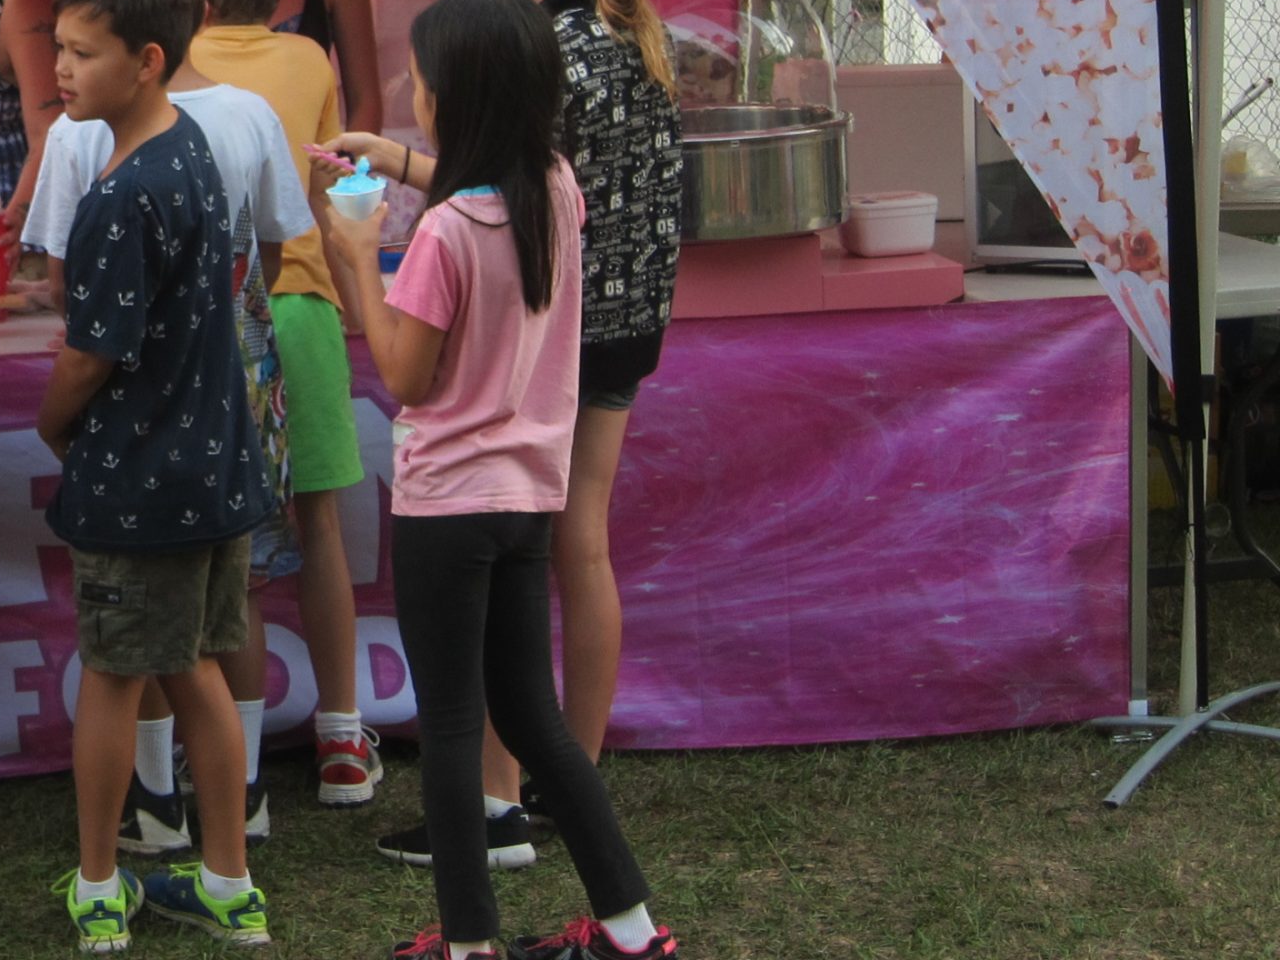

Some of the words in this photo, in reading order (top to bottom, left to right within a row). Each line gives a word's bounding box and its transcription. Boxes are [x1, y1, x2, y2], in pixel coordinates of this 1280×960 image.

[567, 62, 587, 83] 05
[613, 106, 625, 123] 05
[656, 132, 671, 148] 05
[575, 149, 591, 167] 05
[657, 218, 676, 234] 05
[605, 279, 625, 297] 05
